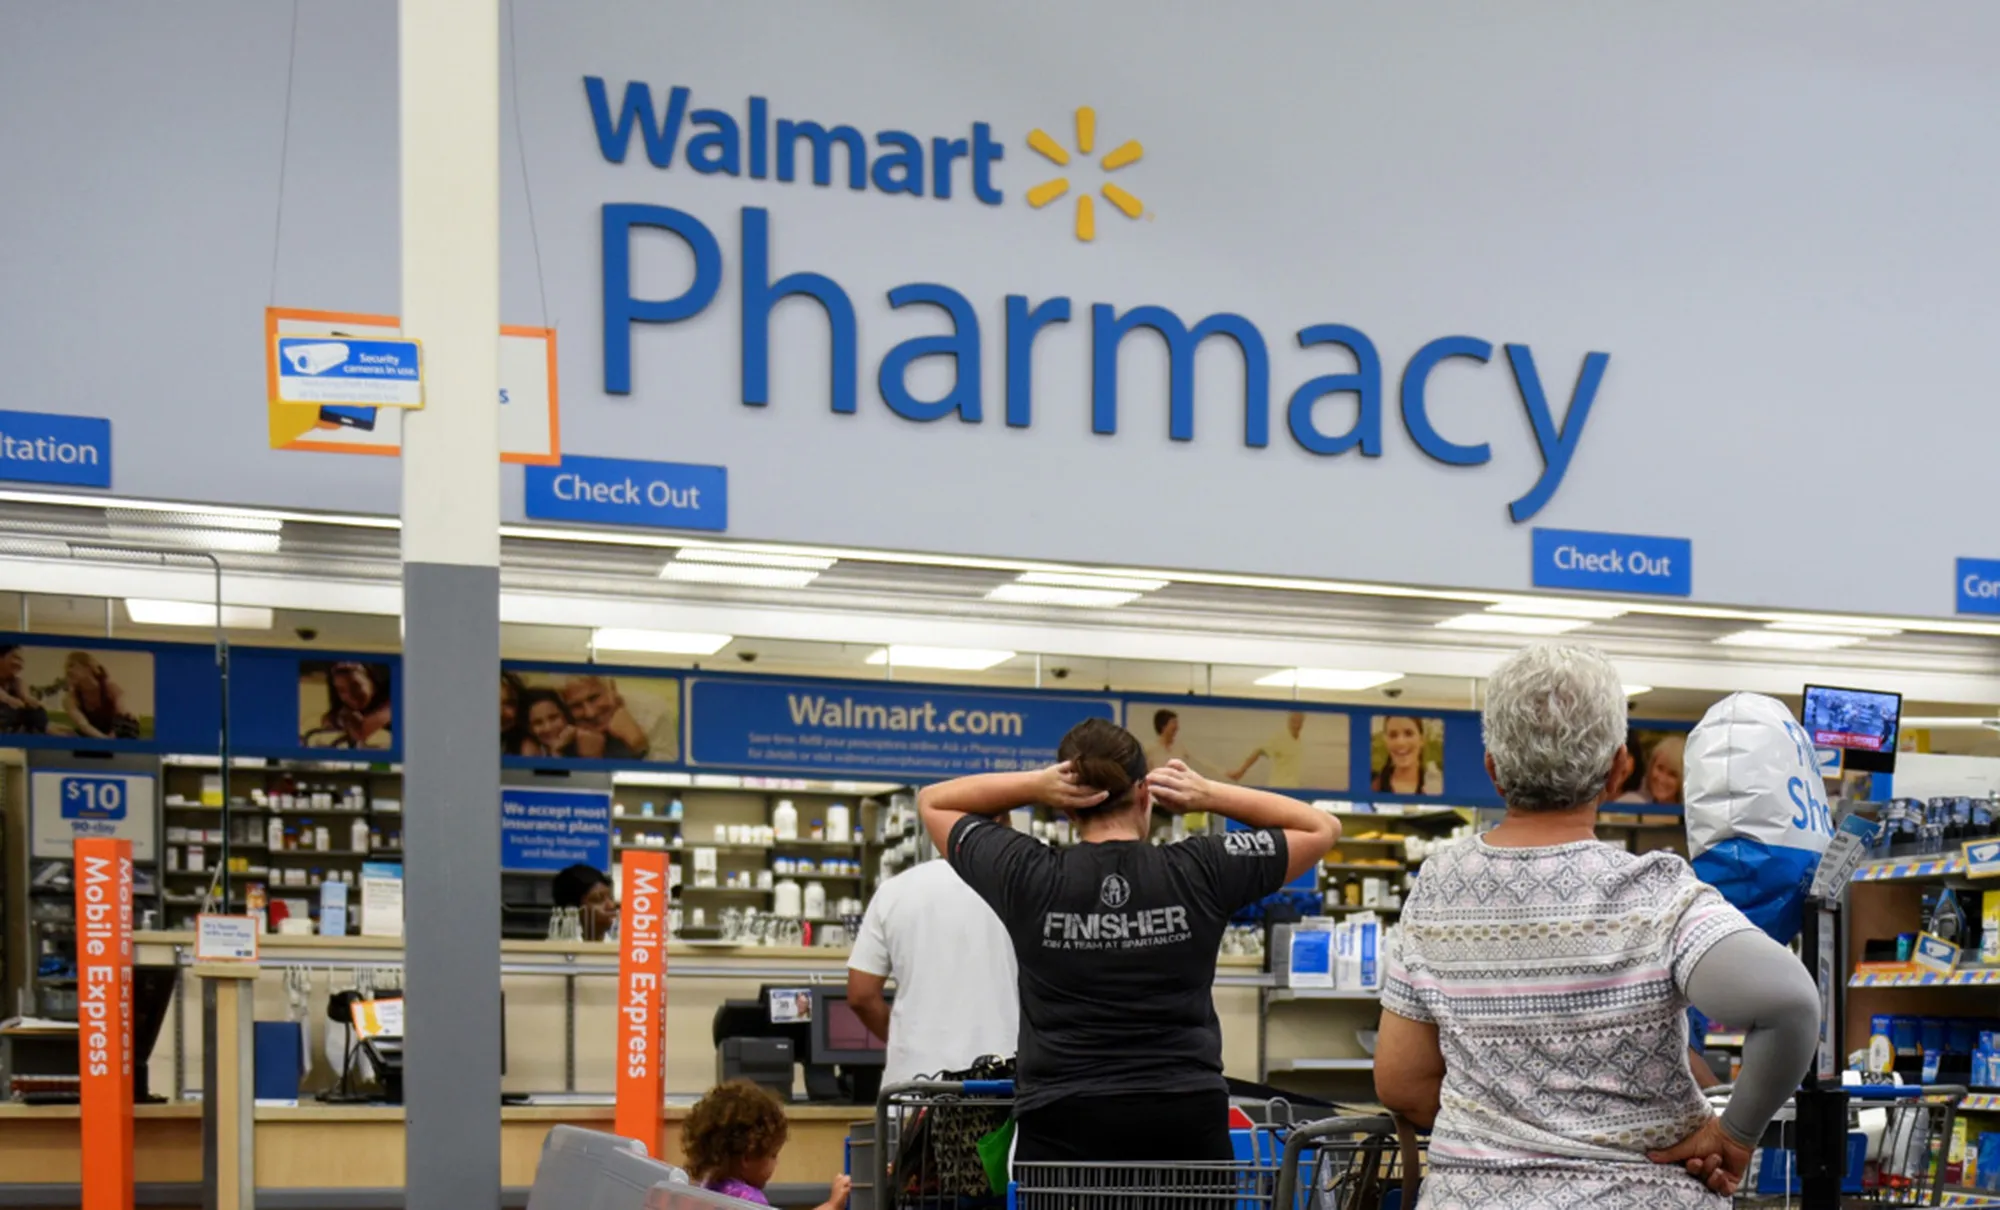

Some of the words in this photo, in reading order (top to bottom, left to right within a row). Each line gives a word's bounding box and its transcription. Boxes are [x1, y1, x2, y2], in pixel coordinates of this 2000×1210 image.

[583, 75, 1003, 206] Walmart
[343, 364, 385, 375] cameras
[386, 364, 397, 375] in
[359, 352, 400, 366] Security
[601, 202, 1612, 524] Pharmacy
[553, 473, 641, 506] Check
[647, 480, 701, 510] Out
[1553, 545, 1624, 573] Check
[1628, 551, 1672, 577] Out
[787, 694, 1023, 737] Walmart.com
[66, 780, 121, 810] $10
[503, 801, 525, 816] We
[528, 804, 571, 820] accept
[574, 806, 607, 818] most
[502, 817, 567, 832] insurance
[84, 856, 112, 956] Mobile
[632, 868, 659, 964] Mobile
[1043, 905, 1190, 940] FINISHER
[81, 965, 113, 1076] Express
[623, 973, 656, 1079] Express
